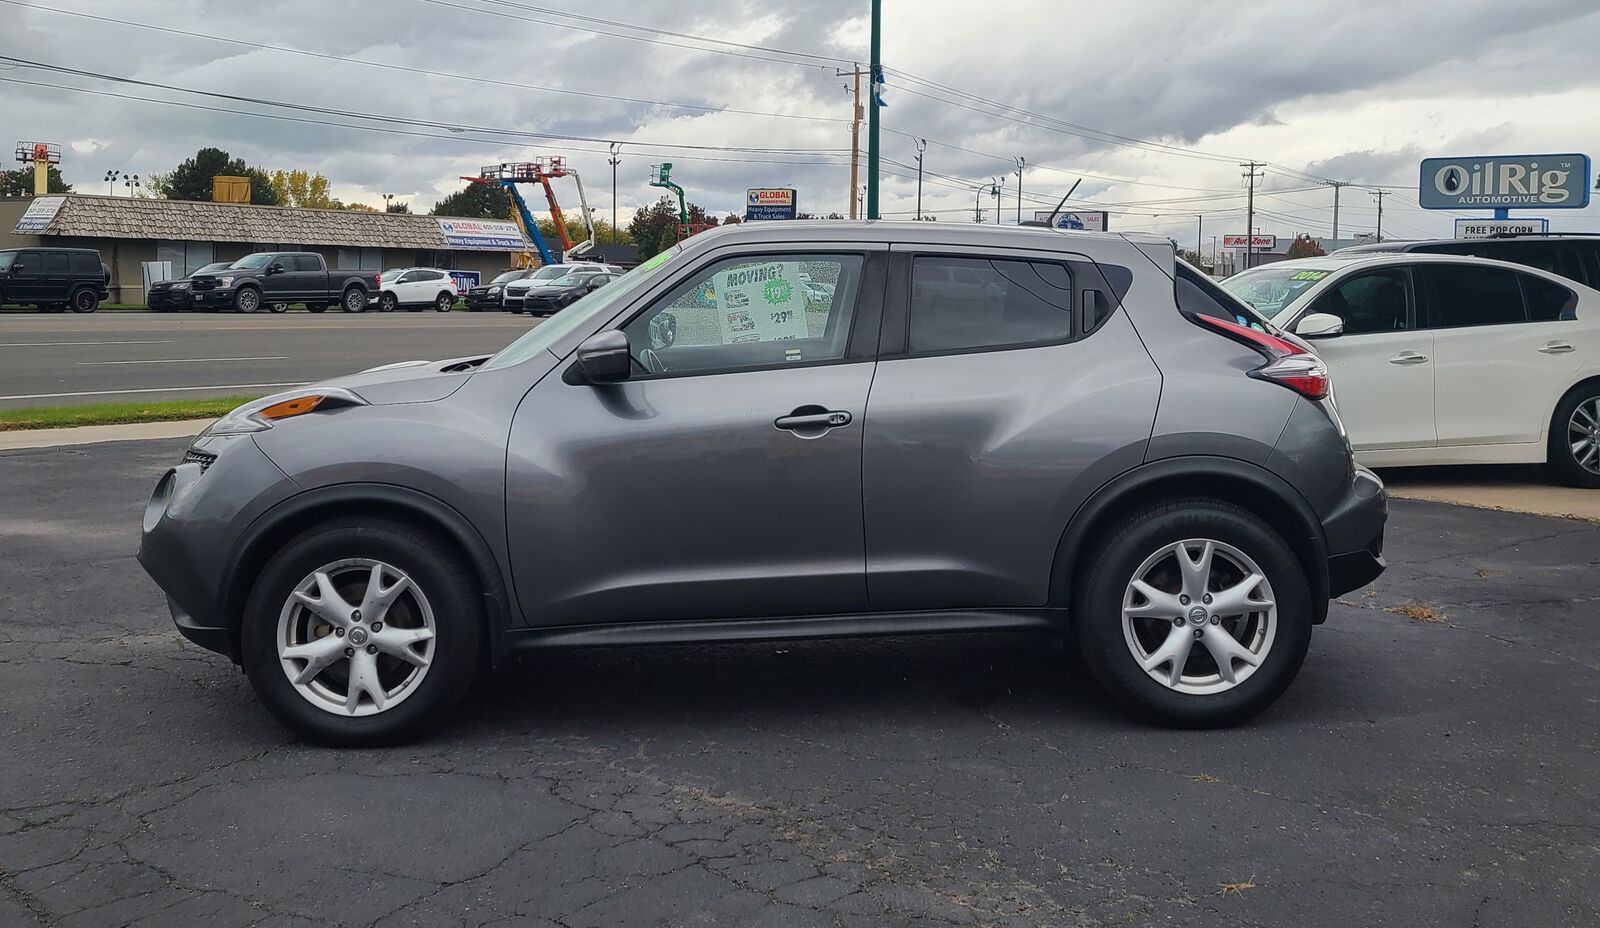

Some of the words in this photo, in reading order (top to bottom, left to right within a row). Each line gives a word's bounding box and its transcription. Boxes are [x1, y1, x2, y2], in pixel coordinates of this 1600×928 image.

[760, 191, 790, 199] GLOBAL
[1458, 196, 1539, 204] AUTOMOTIVE
[453, 222, 482, 230] GLOBAL
[1465, 226, 1487, 234] FREE
[1490, 226, 1533, 234] POPCORN
[448, 237, 464, 245] Heavy
[464, 238, 491, 246] Equipment
[727, 264, 784, 287] MOVING?
